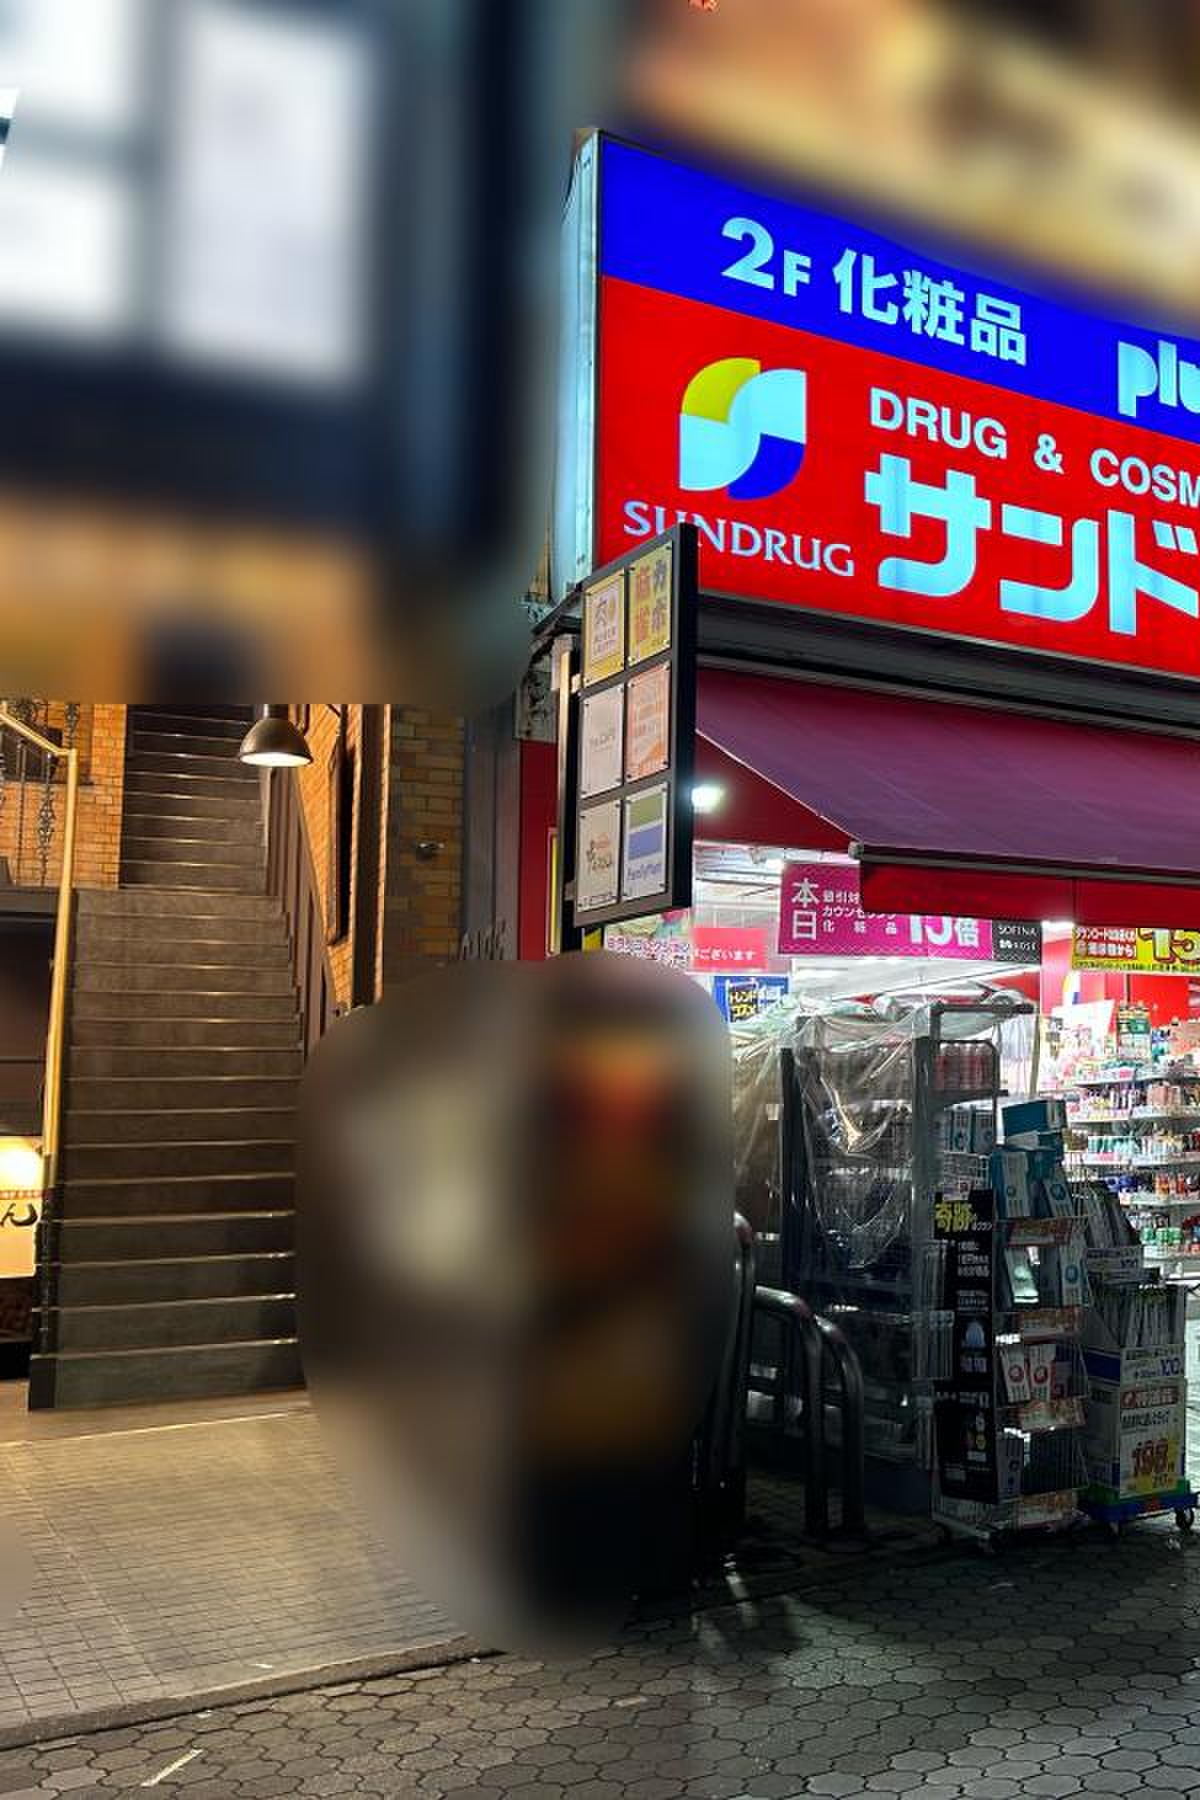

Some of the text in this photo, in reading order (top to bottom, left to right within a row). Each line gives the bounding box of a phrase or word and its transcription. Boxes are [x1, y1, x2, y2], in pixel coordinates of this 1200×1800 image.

[721, 216, 1028, 367] 2F 化粧品
[870, 387, 1008, 460] DRUG
[1033, 433, 1065, 474] &
[622, 499, 855, 577] SUNDRUG
[791, 878, 820, 941] 本日
